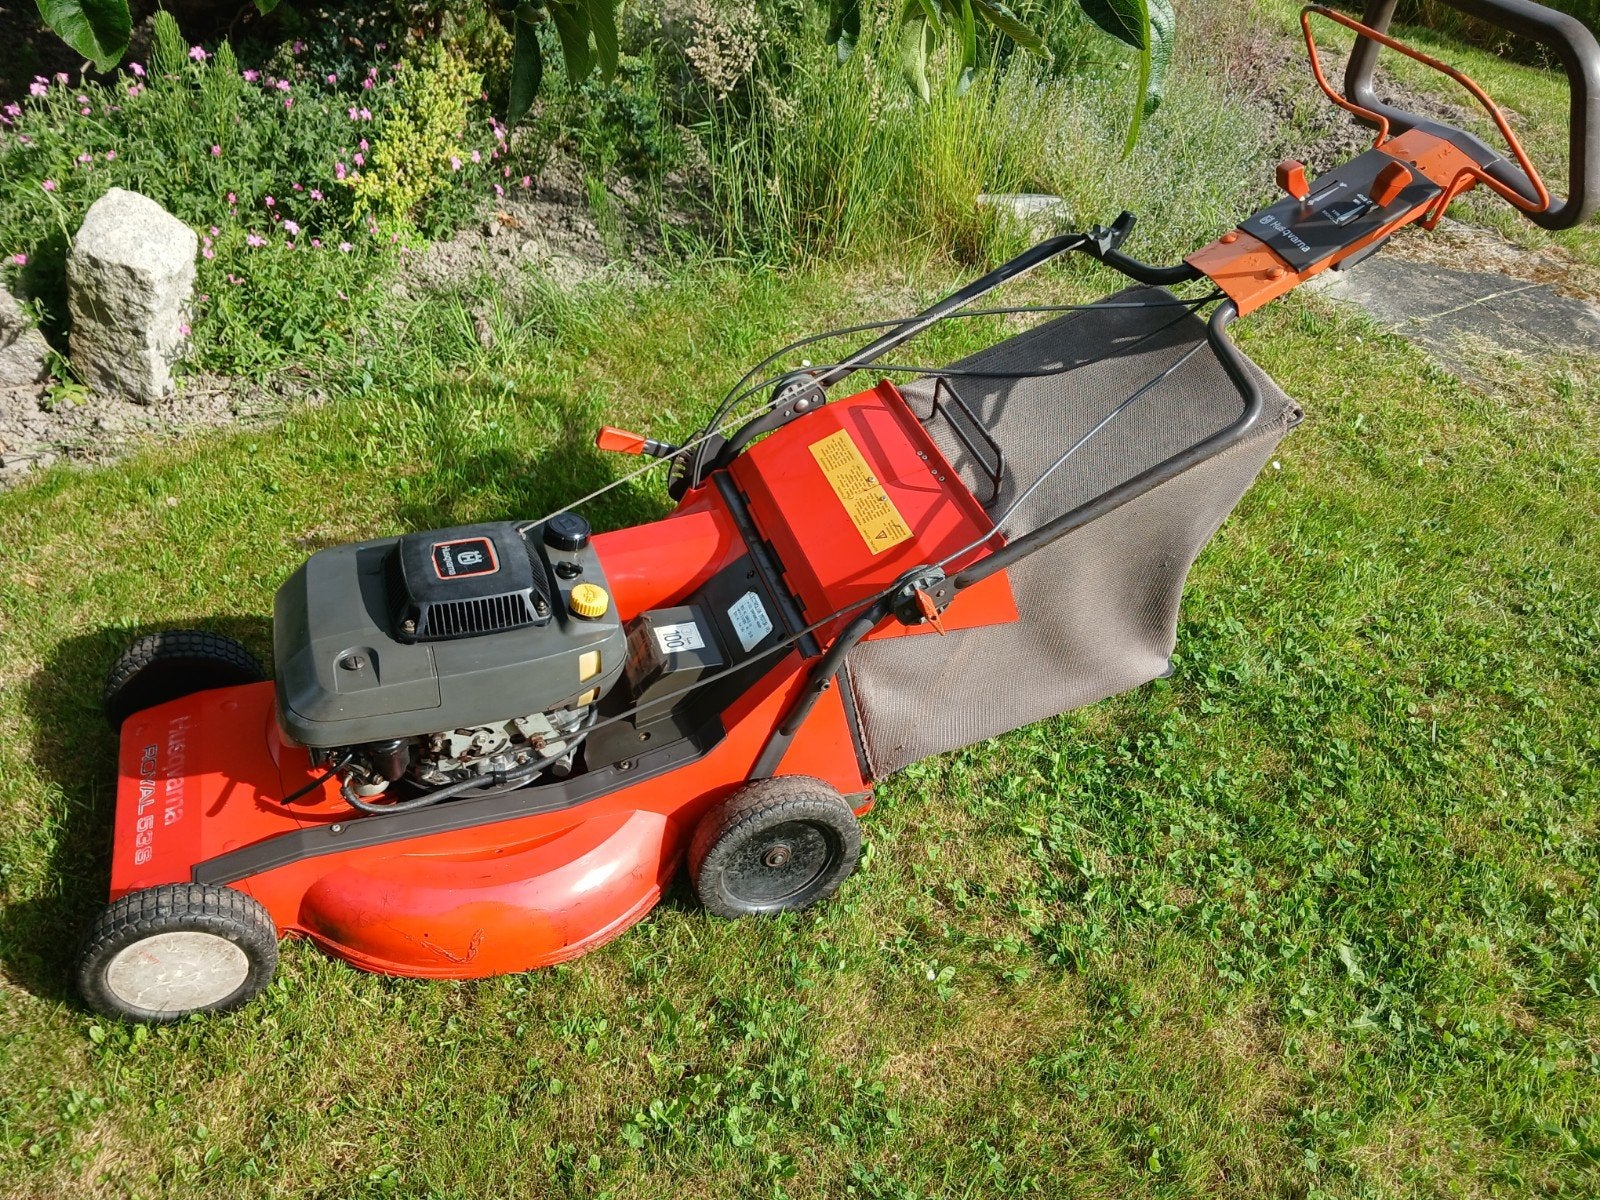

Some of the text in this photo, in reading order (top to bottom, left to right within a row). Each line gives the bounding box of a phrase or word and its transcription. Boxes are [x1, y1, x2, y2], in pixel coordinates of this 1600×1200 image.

[1270, 220, 1311, 253] Husqvarna
[663, 629, 685, 649] 100
[137, 743, 158, 816] ROYAL
[164, 715, 192, 826] Husqvarna
